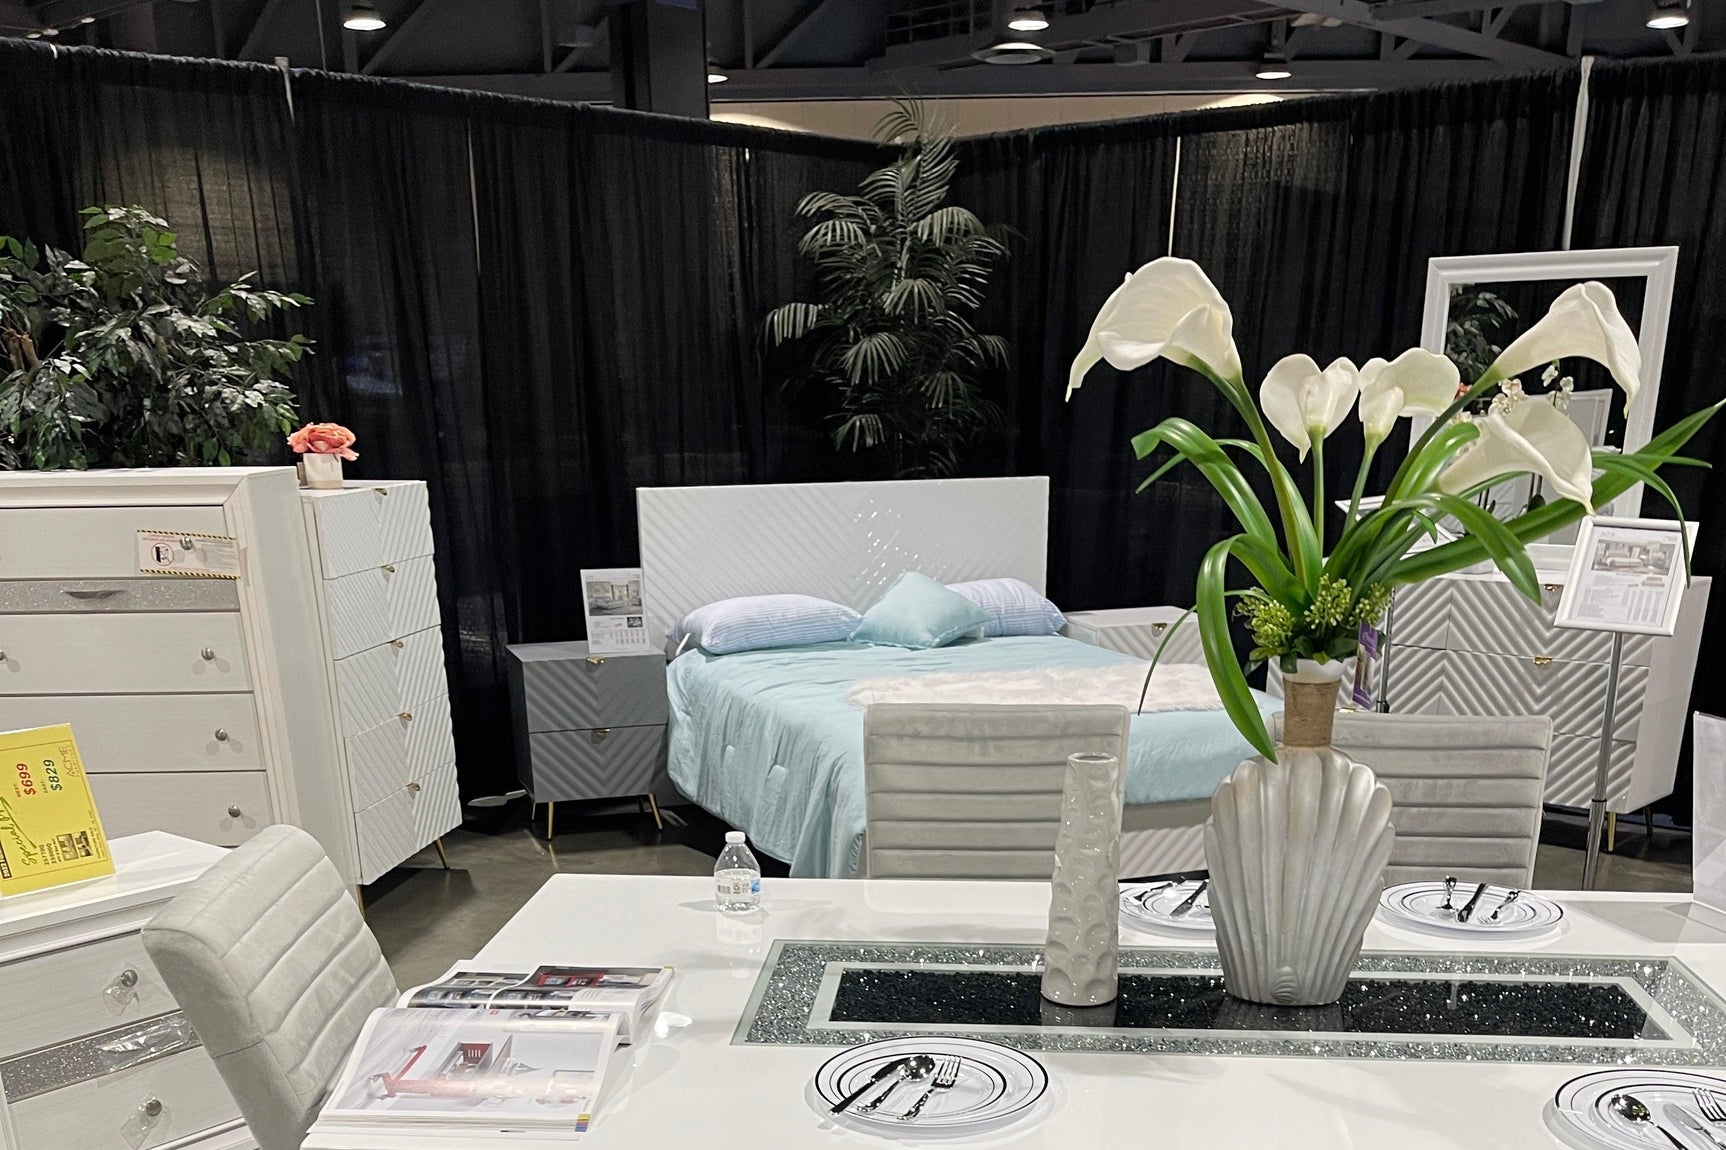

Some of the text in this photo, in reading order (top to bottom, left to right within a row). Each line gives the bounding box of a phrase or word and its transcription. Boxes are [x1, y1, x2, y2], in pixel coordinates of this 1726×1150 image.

[43, 759, 63, 791] $829
[58, 746, 77, 777] ACME
[16, 763, 36, 796] $699
